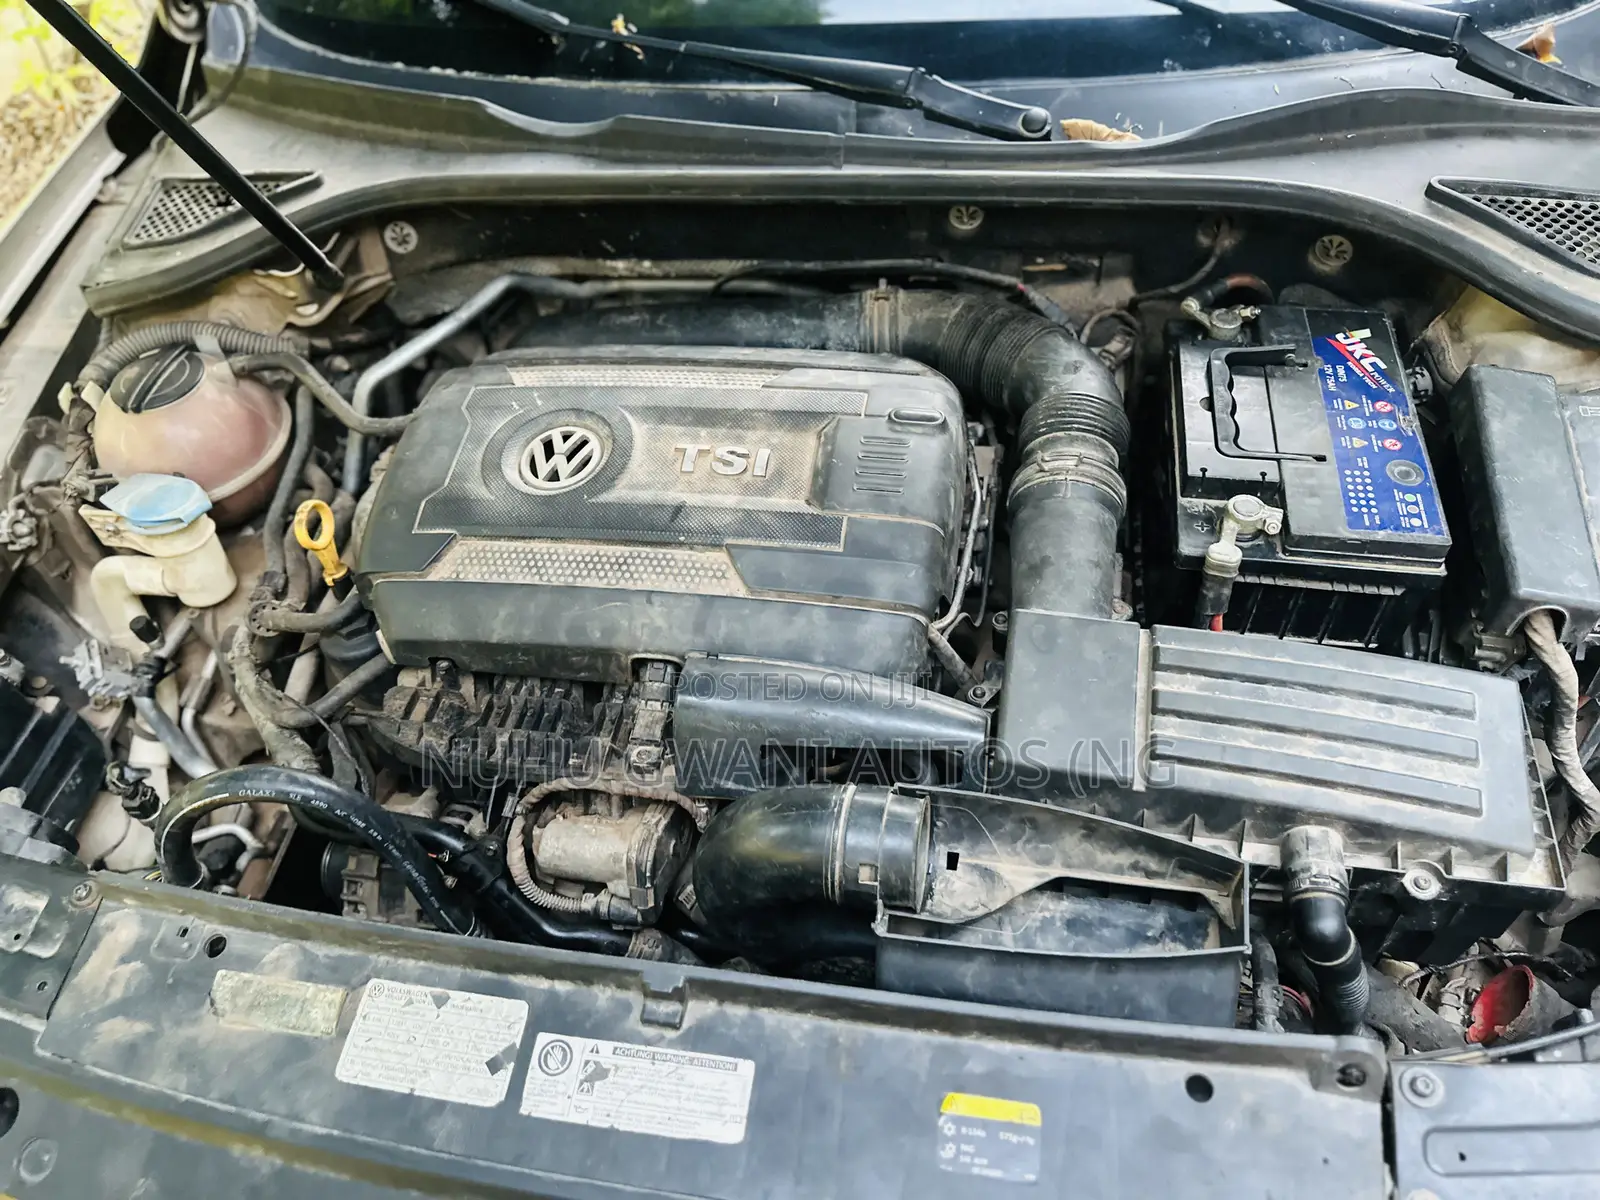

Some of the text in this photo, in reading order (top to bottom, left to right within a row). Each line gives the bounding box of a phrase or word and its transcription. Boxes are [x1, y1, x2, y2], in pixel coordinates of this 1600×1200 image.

[1323, 364, 1337, 391] 12V 75AH
[1335, 328, 1396, 393] JKC POWER
[675, 443, 771, 478] TSI
